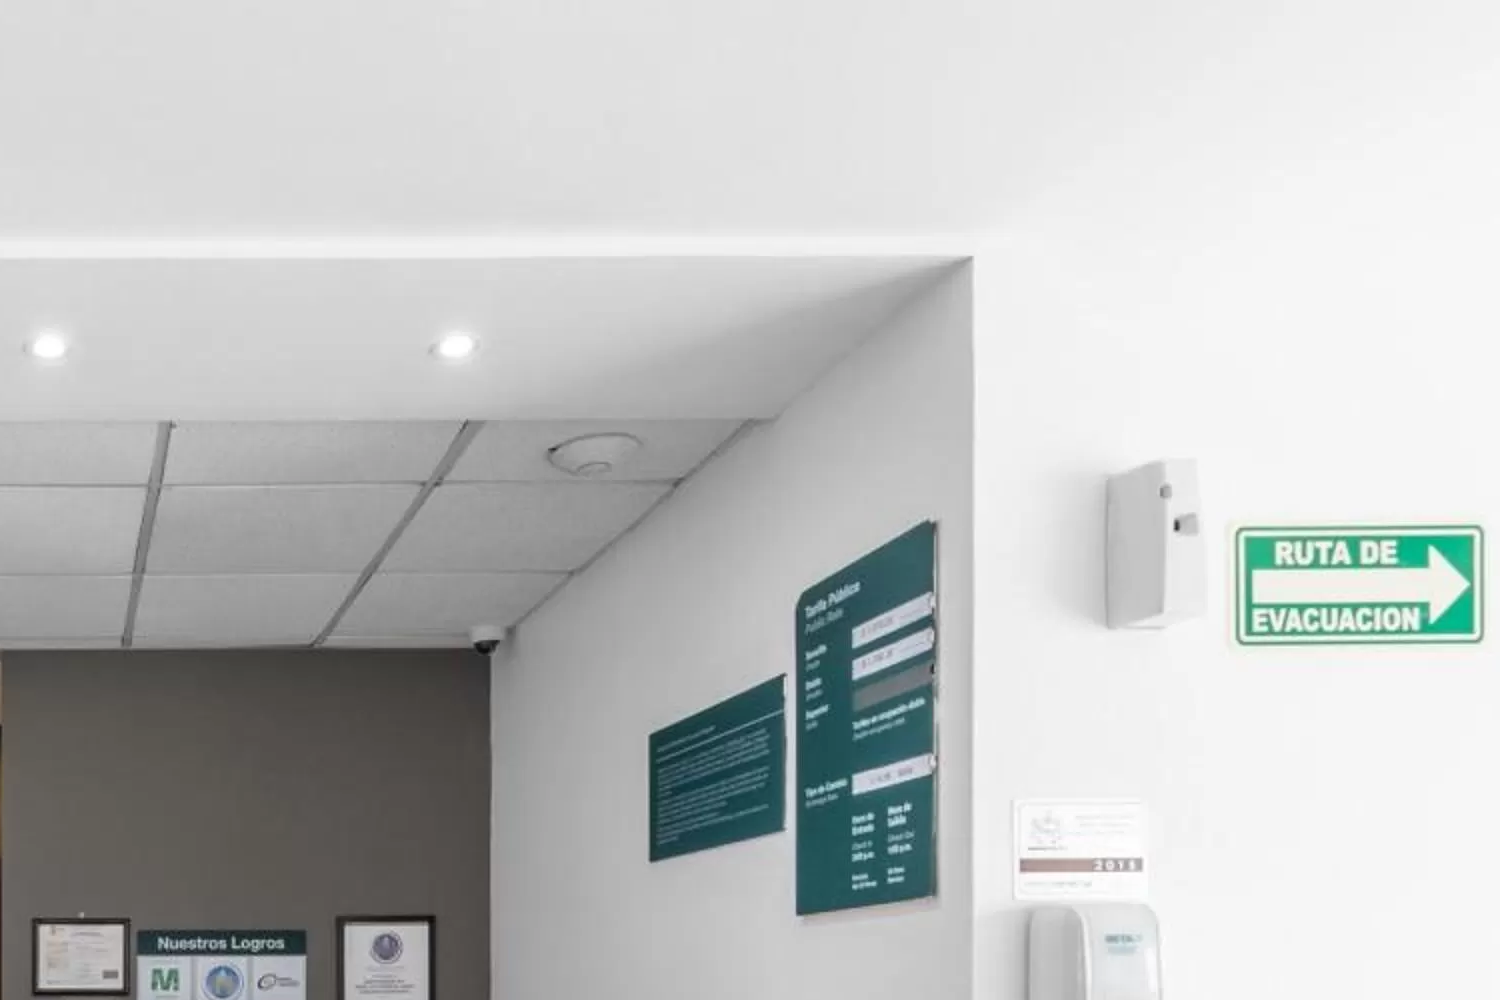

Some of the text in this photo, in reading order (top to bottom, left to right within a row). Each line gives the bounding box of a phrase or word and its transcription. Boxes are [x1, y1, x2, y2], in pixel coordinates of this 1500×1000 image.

[1274, 540, 1399, 566] RUTA DE
[1252, 606, 1422, 633] EVACUACION
[157, 936, 286, 952] Nuestros Logros
[150, 967, 181, 992] M
